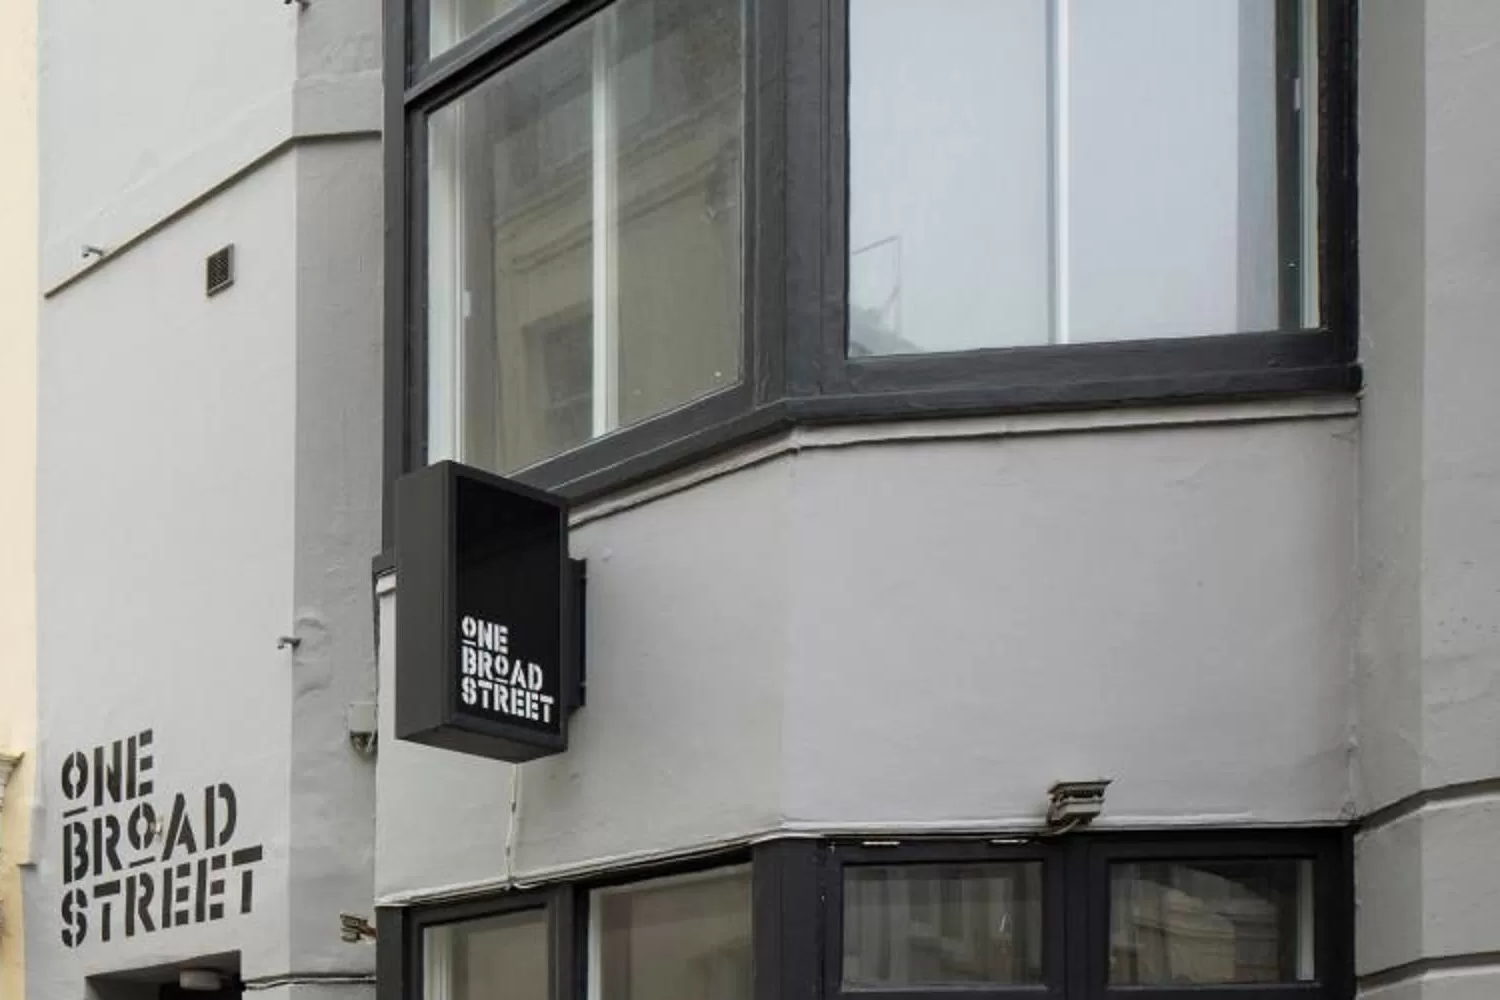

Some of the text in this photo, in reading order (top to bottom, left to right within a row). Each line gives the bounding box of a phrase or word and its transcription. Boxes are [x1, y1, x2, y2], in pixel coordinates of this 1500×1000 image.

[462, 615, 508, 653] ONE
[462, 646, 543, 691] BROAD
[462, 676, 554, 723] STREET
[61, 728, 153, 817] ONE
[62, 783, 237, 884] BROAD
[61, 844, 263, 949] STREET
